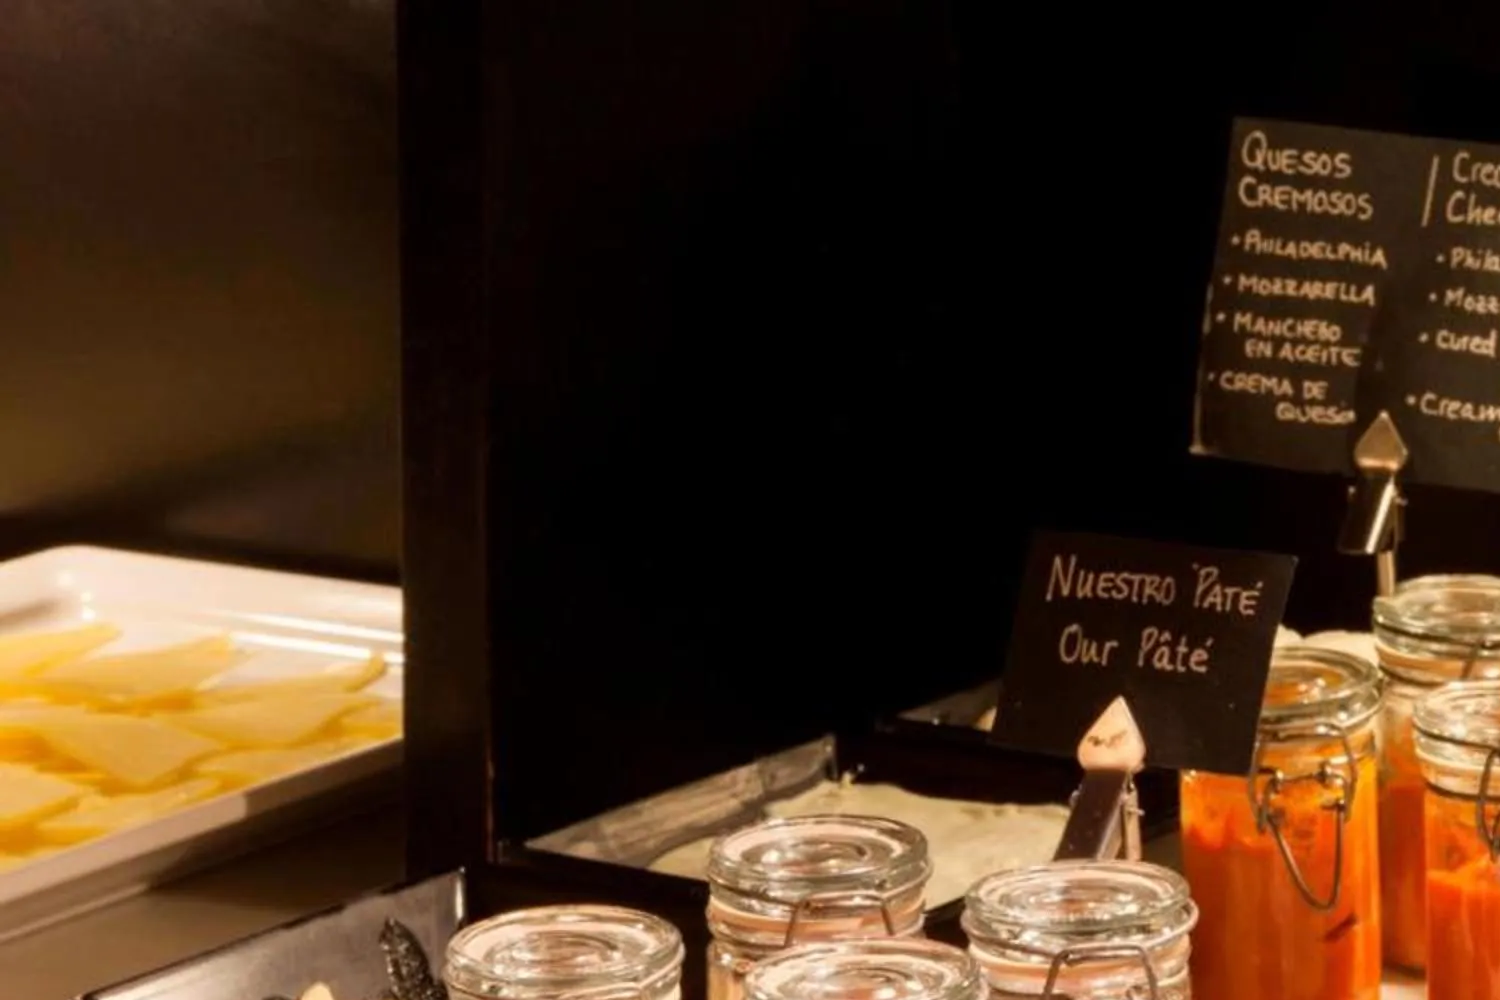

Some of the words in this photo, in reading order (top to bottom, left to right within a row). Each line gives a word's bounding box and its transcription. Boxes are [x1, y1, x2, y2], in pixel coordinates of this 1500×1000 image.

[1241, 130, 1352, 179] QUESOS
[1237, 175, 1375, 221] CREMOSOS
[1237, 272, 1376, 308] MOZZARELLA
[1244, 337, 1274, 359] EN
[1278, 340, 1362, 368] ACEITE
[1218, 370, 1295, 398] CREMA
[1302, 379, 1329, 401] DE
[1046, 553, 1176, 606] NUESTRO
[1058, 622, 1119, 667] Our
[1137, 626, 1215, 674] Pâté
